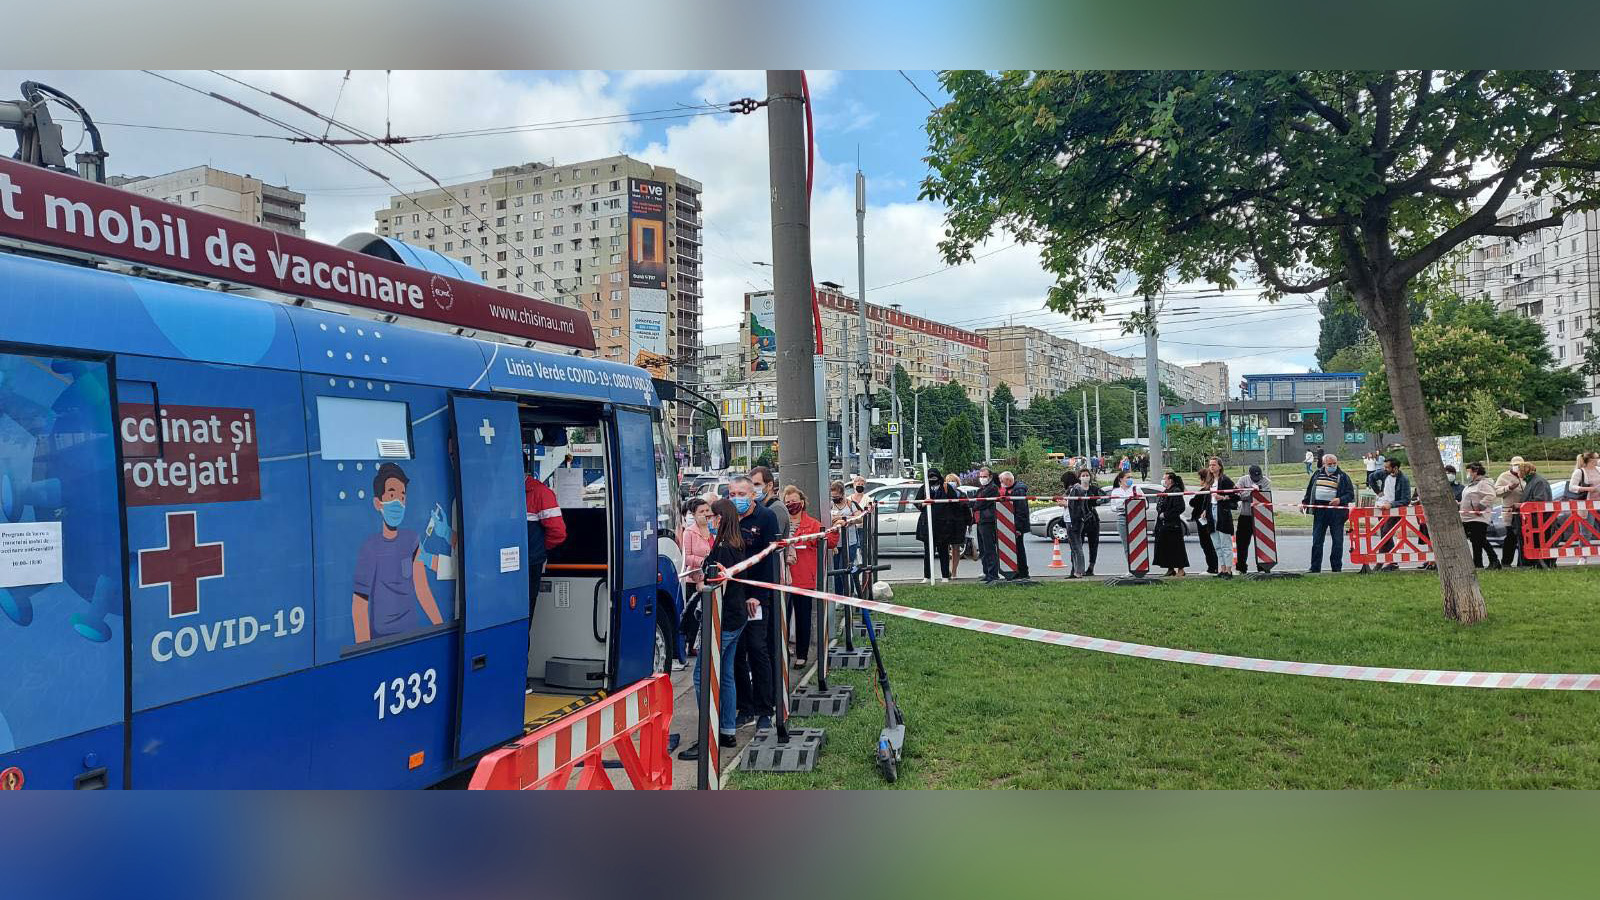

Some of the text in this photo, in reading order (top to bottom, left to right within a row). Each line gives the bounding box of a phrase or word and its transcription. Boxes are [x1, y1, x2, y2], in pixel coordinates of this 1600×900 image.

[631, 180, 663, 195] Love
[44, 194, 190, 259] mobil
[204, 228, 256, 273] de
[267, 249, 424, 310] vaccinare
[489, 303, 575, 334] www.chisinau.md
[505, 358, 534, 377] Linia
[534, 362, 566, 381] Verde
[566, 366, 613, 387] COVID-19:
[230, 413, 252, 451] și
[151, 606, 305, 662] COVID-19
[373, 668, 437, 720] 1333
